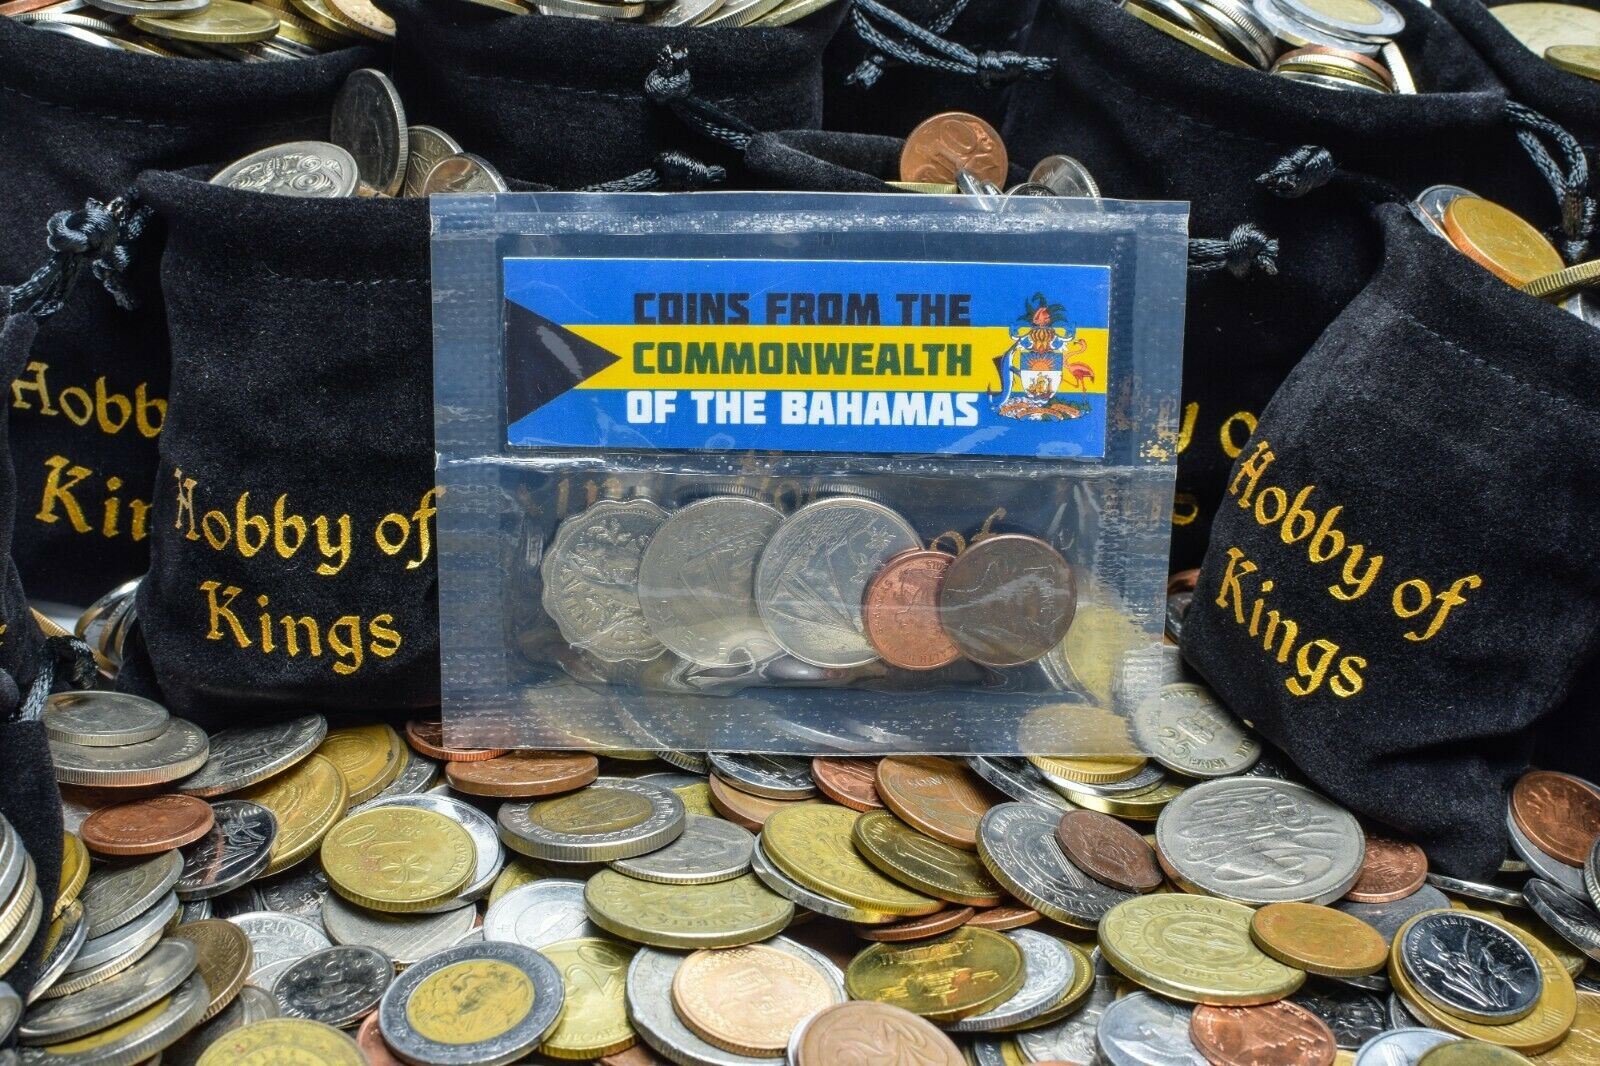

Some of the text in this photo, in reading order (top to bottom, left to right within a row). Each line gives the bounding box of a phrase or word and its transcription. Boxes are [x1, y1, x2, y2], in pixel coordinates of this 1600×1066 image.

[633, 292, 972, 327] COINS FROM THE
[632, 341, 973, 377] COMMONWEALTH
[626, 390, 980, 427] OF THE BAHAMAS
[174, 468, 447, 576] Hobby of
[1229, 440, 1483, 641] Hobby of
[200, 580, 402, 676] Kings
[1215, 546, 1368, 698] Kings
